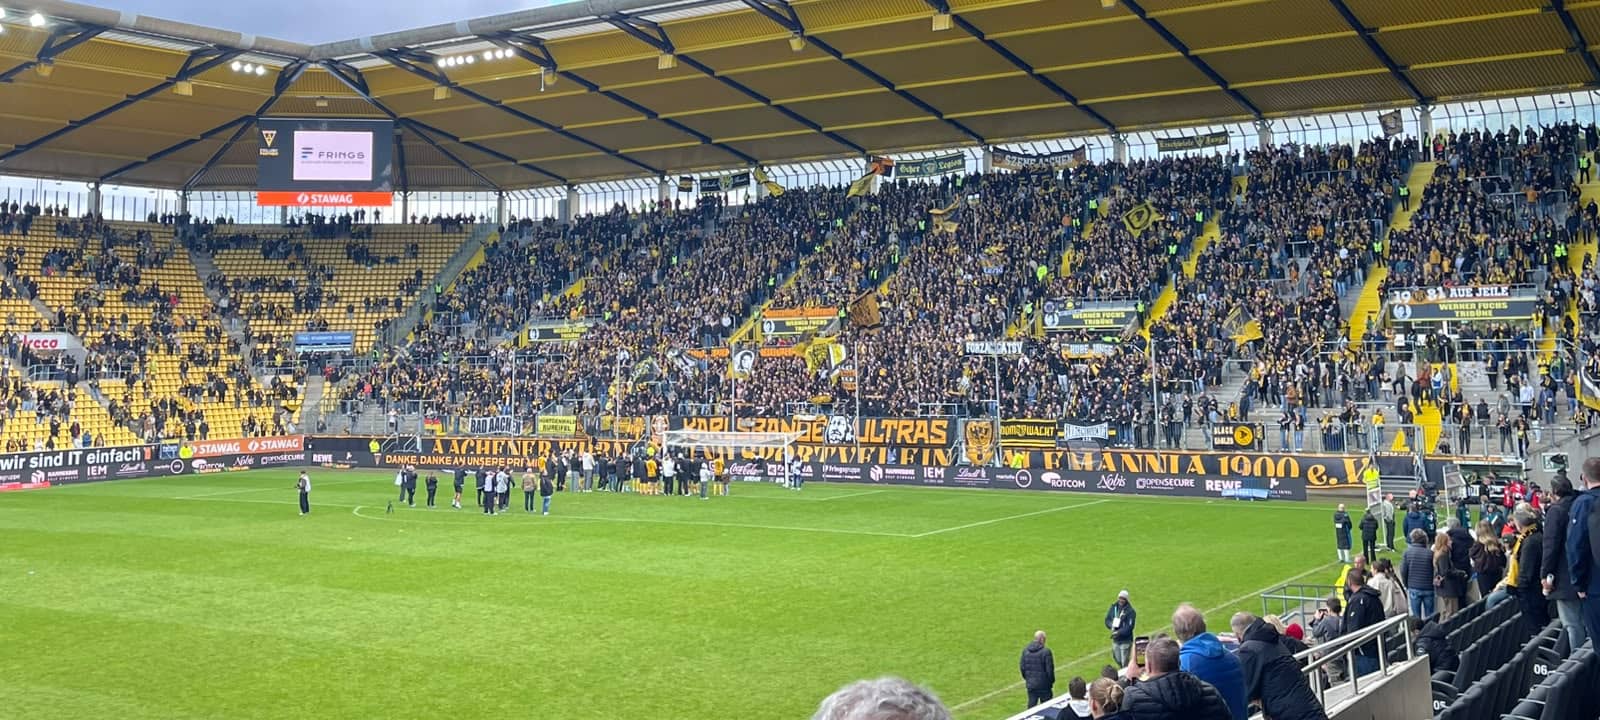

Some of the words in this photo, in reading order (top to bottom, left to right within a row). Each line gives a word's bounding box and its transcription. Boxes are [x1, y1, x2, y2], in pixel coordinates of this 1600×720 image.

[310, 194, 353, 204] STAWAG
[1478, 302, 1508, 310] FUCHS
[470, 418, 487, 434] BAD
[488, 415, 522, 435] AACHEN
[856, 418, 948, 444] ULTRAS
[200, 442, 241, 453] STAWAG
[260, 439, 299, 450] STAWAG
[1, 455, 26, 470] wir
[29, 452, 63, 468] sind
[68, 451, 83, 465] IT
[86, 447, 141, 464] einfach
[313, 454, 333, 463] REWE
[386, 455, 419, 466] DANKE,
[420, 455, 451, 466] DANKE
[467, 456, 505, 467] UNSERE
[88, 466, 107, 476] IEM
[923, 467, 945, 479] IEM
[1051, 479, 1086, 489] ROTCOM
[1096, 473, 1127, 490] Nobis
[1533, 664, 1548, 675] 06
